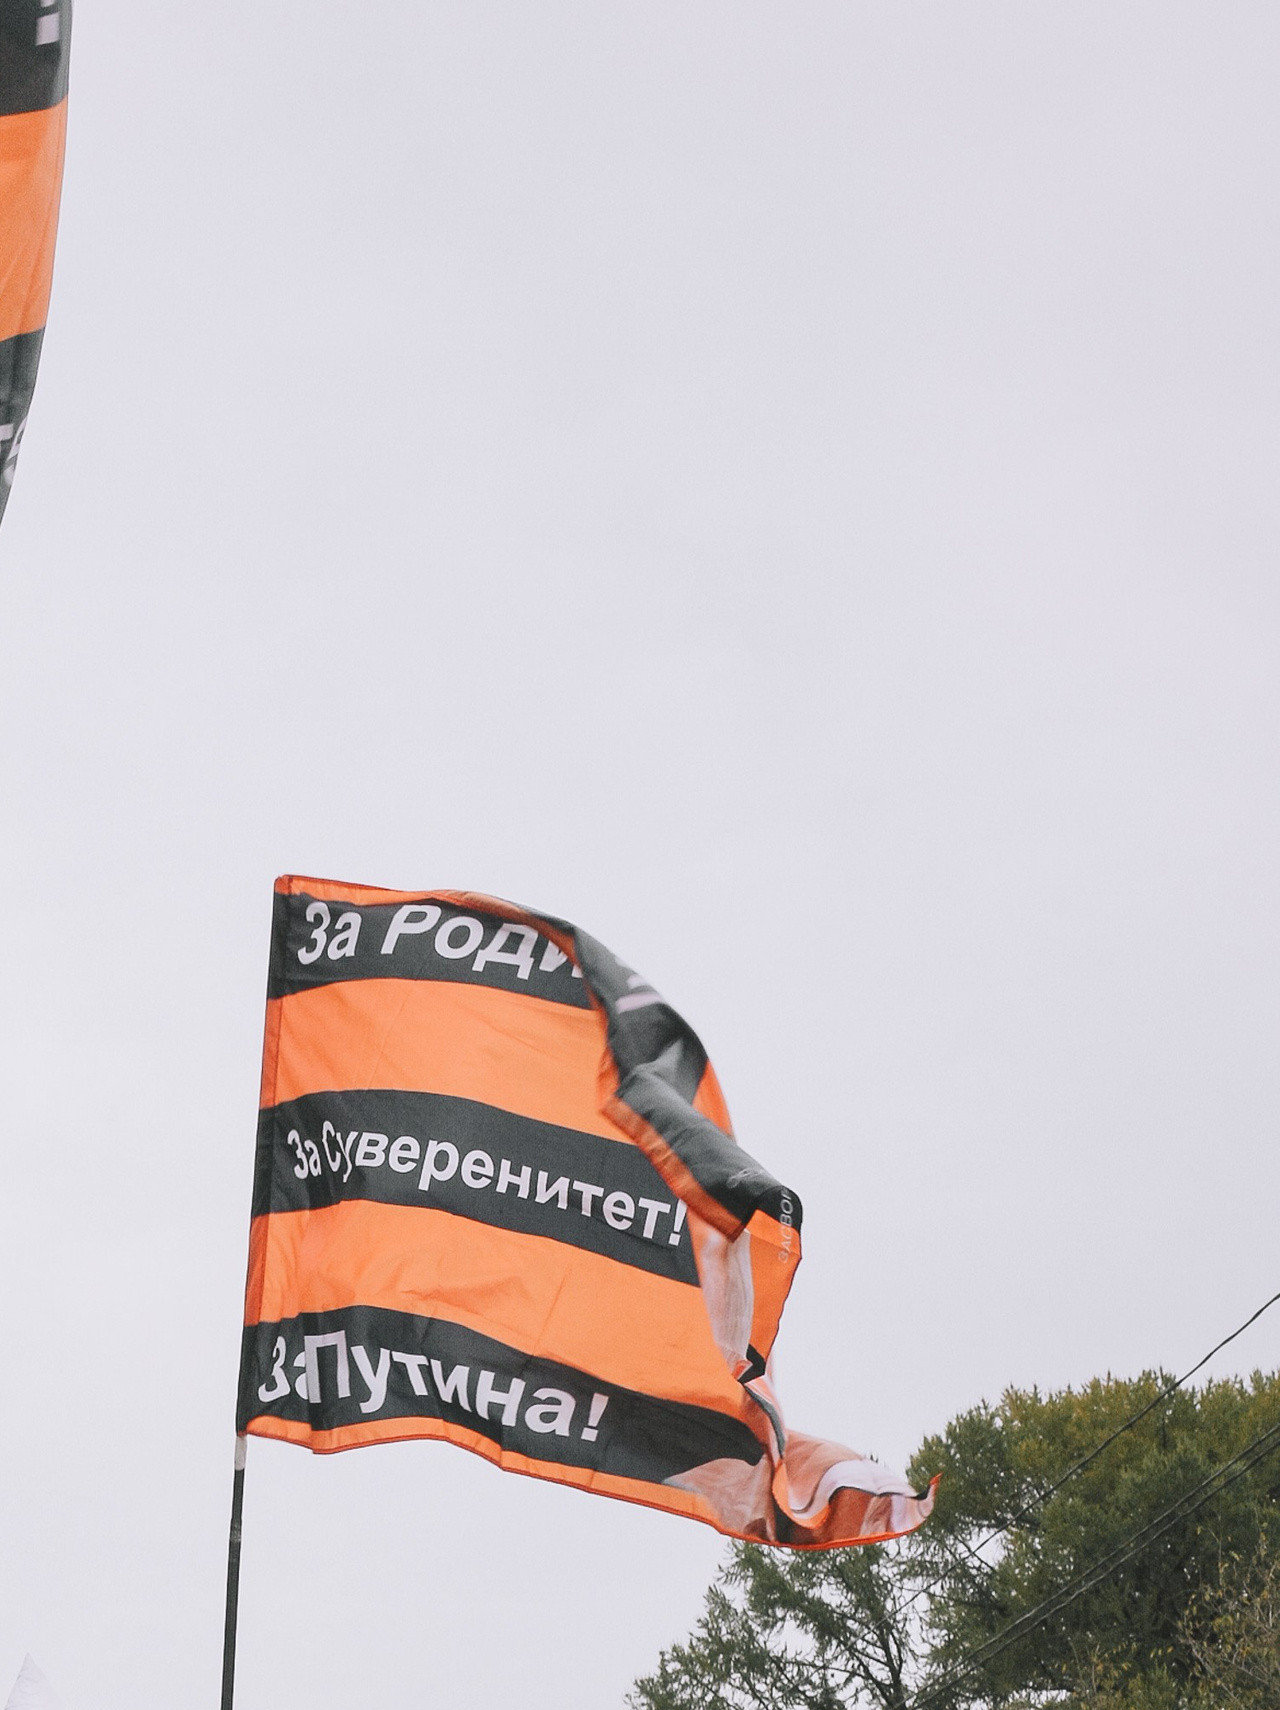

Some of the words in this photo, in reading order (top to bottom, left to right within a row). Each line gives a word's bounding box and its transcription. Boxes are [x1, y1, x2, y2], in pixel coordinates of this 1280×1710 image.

[297, 902, 362, 965] За
[287, 1129, 322, 1180] За
[322, 1120, 688, 1246] Суверенитет!
[304, 1330, 609, 1443] Путина!
